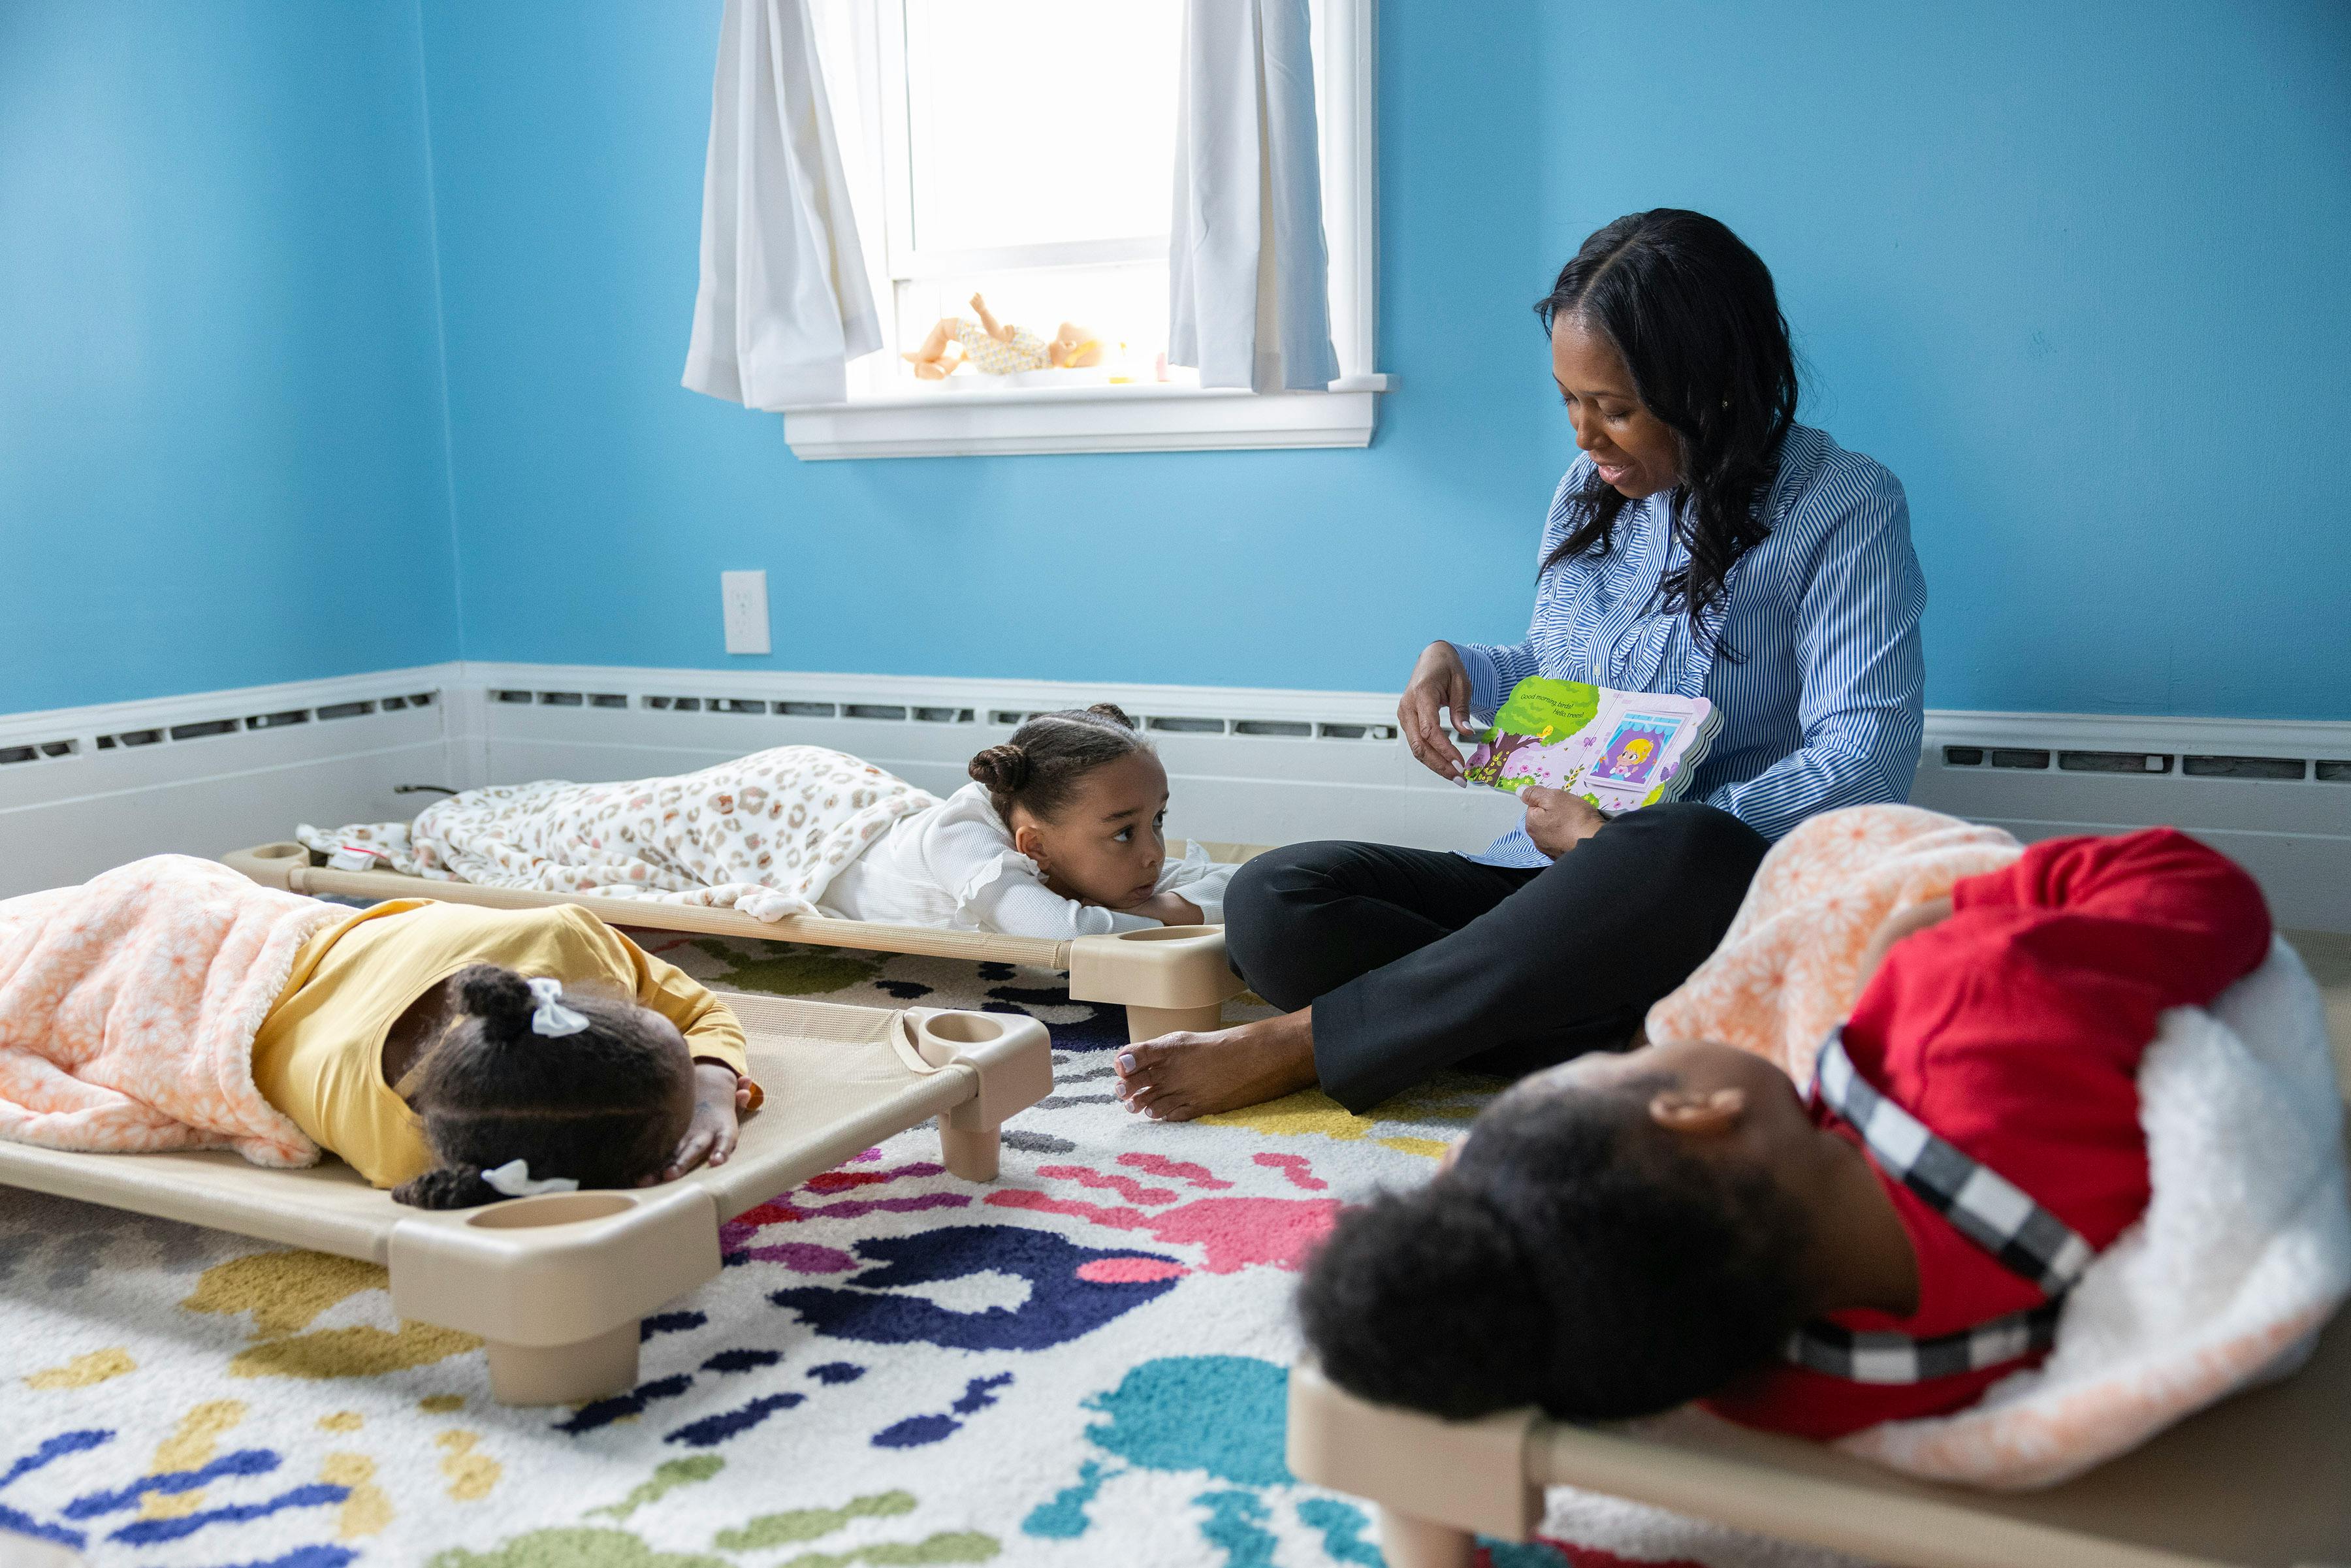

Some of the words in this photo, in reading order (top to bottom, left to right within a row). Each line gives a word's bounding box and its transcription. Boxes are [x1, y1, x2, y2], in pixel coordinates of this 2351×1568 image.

[1536, 695, 1557, 707] morning,
[1558, 701, 1574, 709] birds!
[1553, 709, 1566, 717] Hello,
